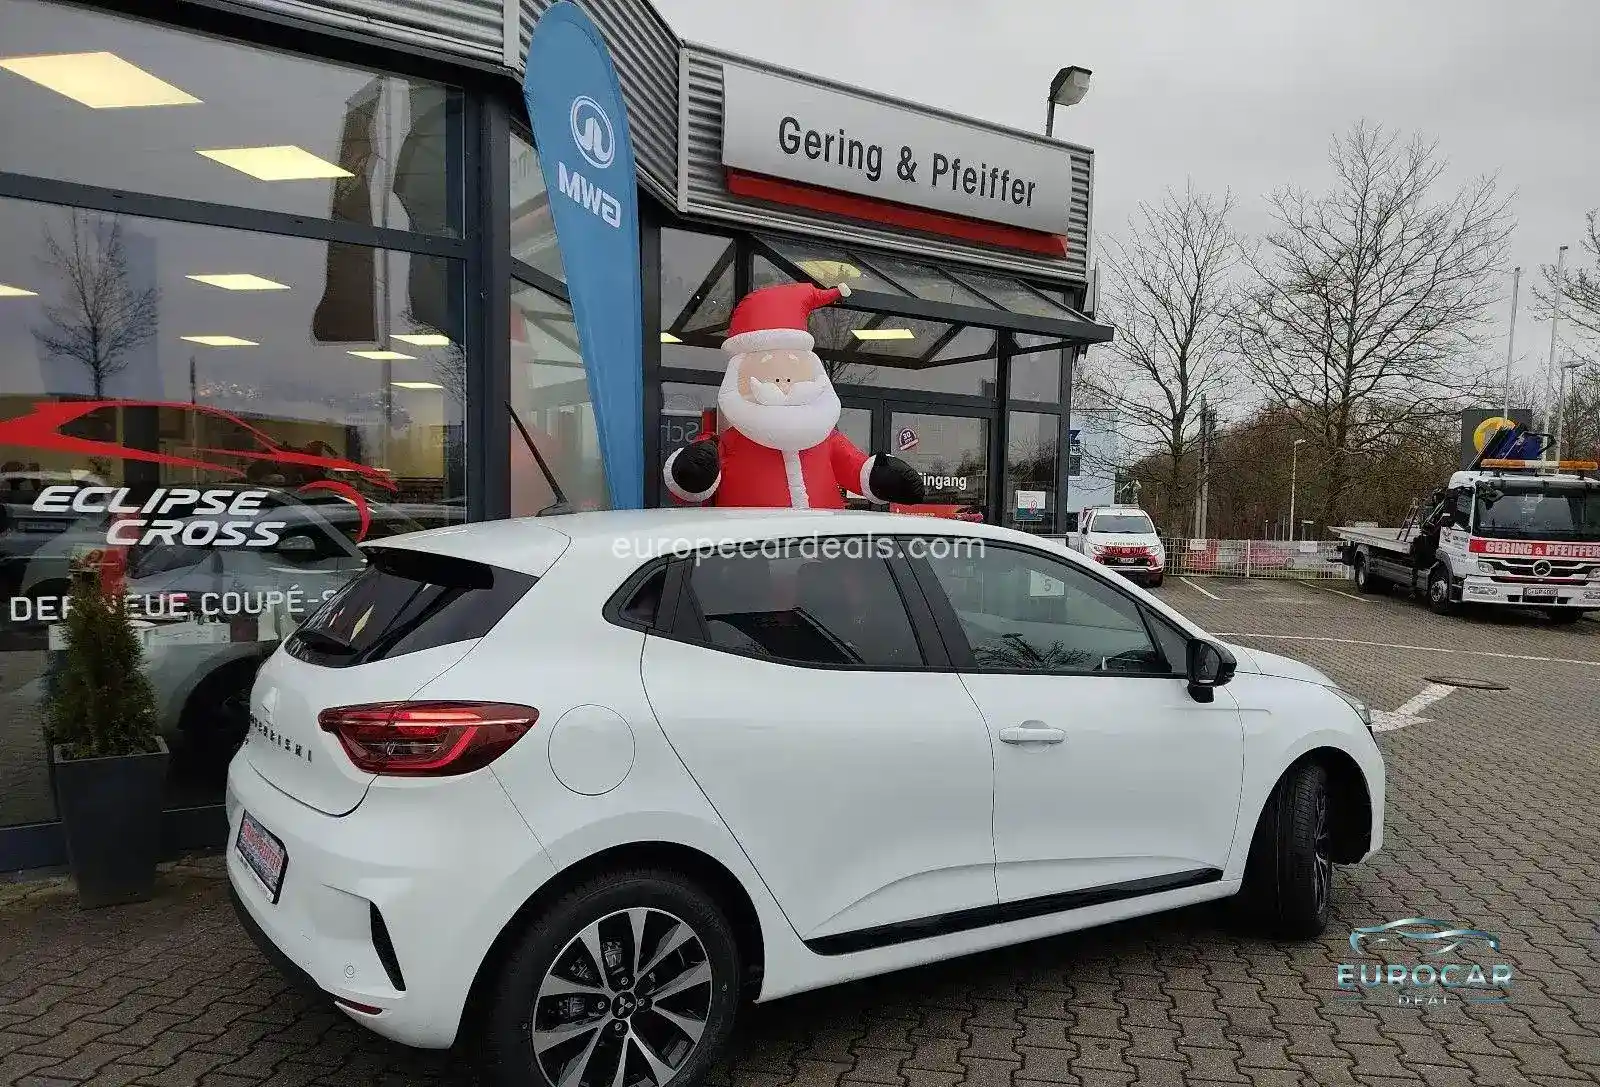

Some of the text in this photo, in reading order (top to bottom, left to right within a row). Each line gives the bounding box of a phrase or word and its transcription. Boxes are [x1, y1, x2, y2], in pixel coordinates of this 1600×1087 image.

[778, 116, 1036, 207] Gering & Pfeiffer
[918, 472, 967, 491] ingang
[32, 485, 270, 516] ECLIPSE
[106, 519, 288, 547] CROSS
[1485, 541, 1533, 555] GERING
[1535, 546, 1544, 556] &
